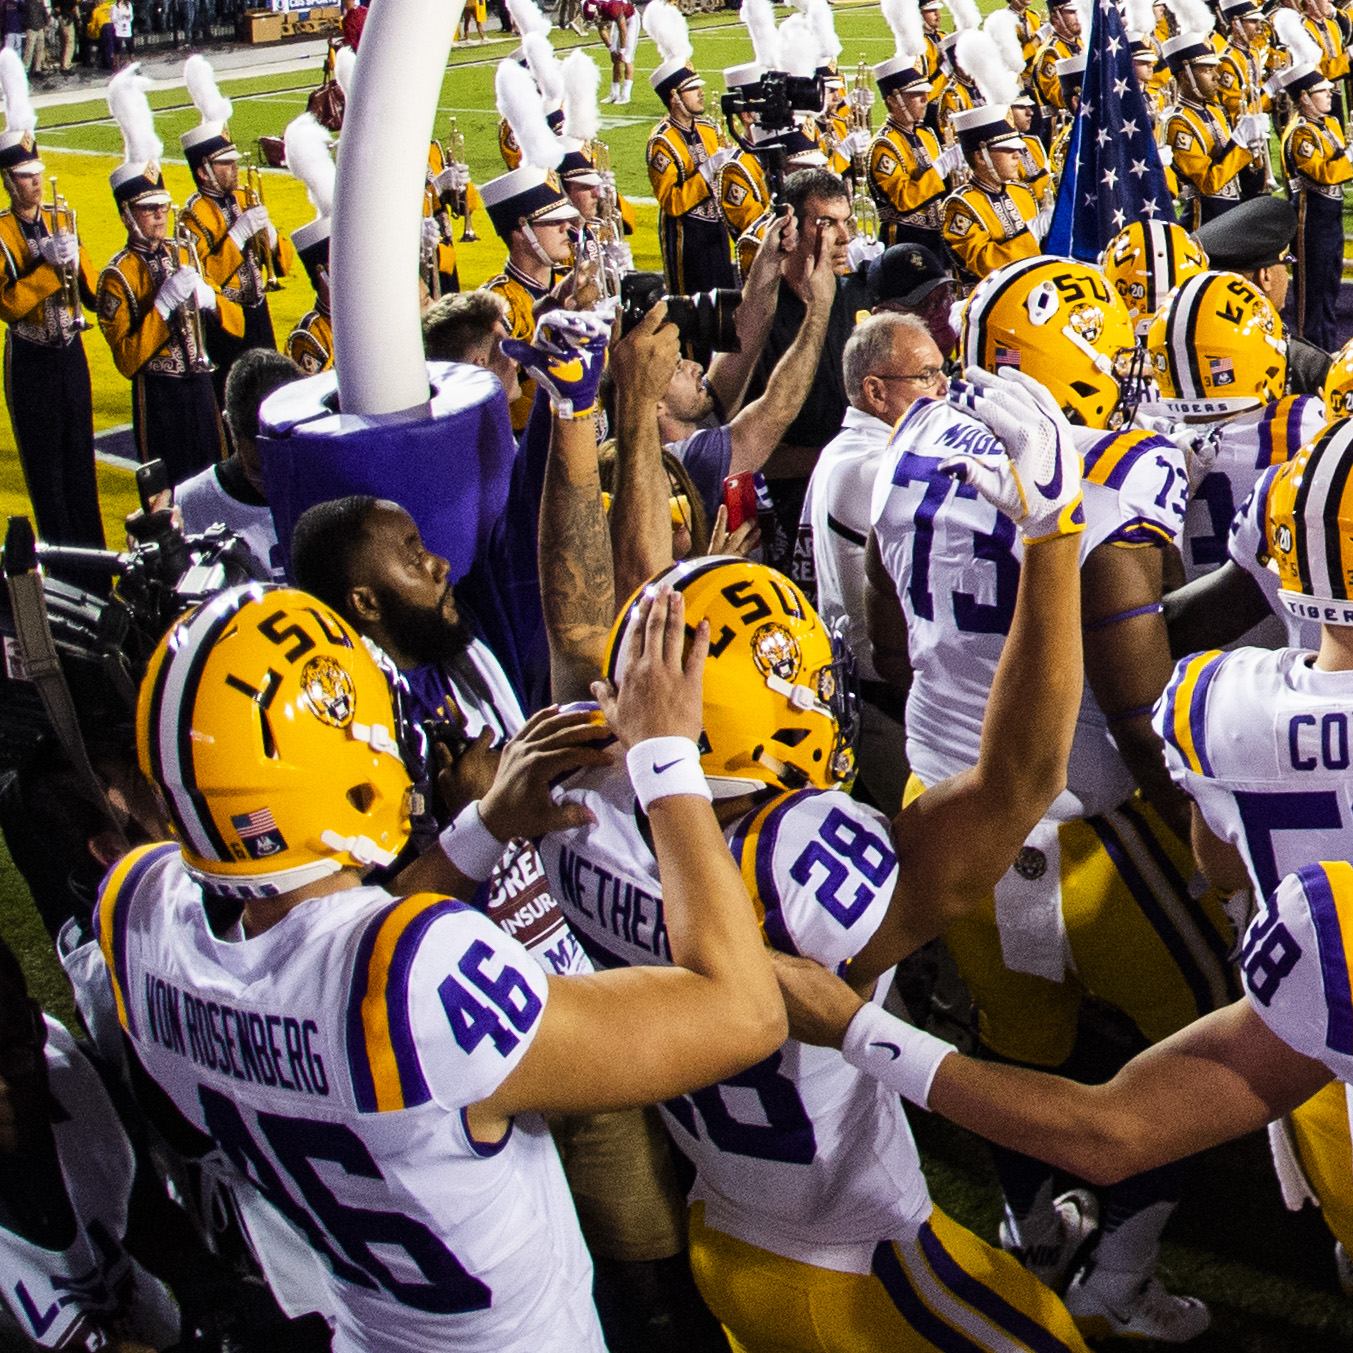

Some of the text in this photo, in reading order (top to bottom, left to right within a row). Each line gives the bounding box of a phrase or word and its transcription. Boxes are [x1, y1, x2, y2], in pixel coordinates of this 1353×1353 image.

[1053, 273, 1110, 303] SU
[1131, 282, 1145, 298] 20
[1216, 280, 1256, 324] LS
[1166, 402, 1228, 413] TIGERS
[789, 806, 898, 930] 28
[500, 893, 558, 937] INSUR
[437, 939, 543, 1059] 46
[144, 970, 330, 1097] VON ROSENBERG
